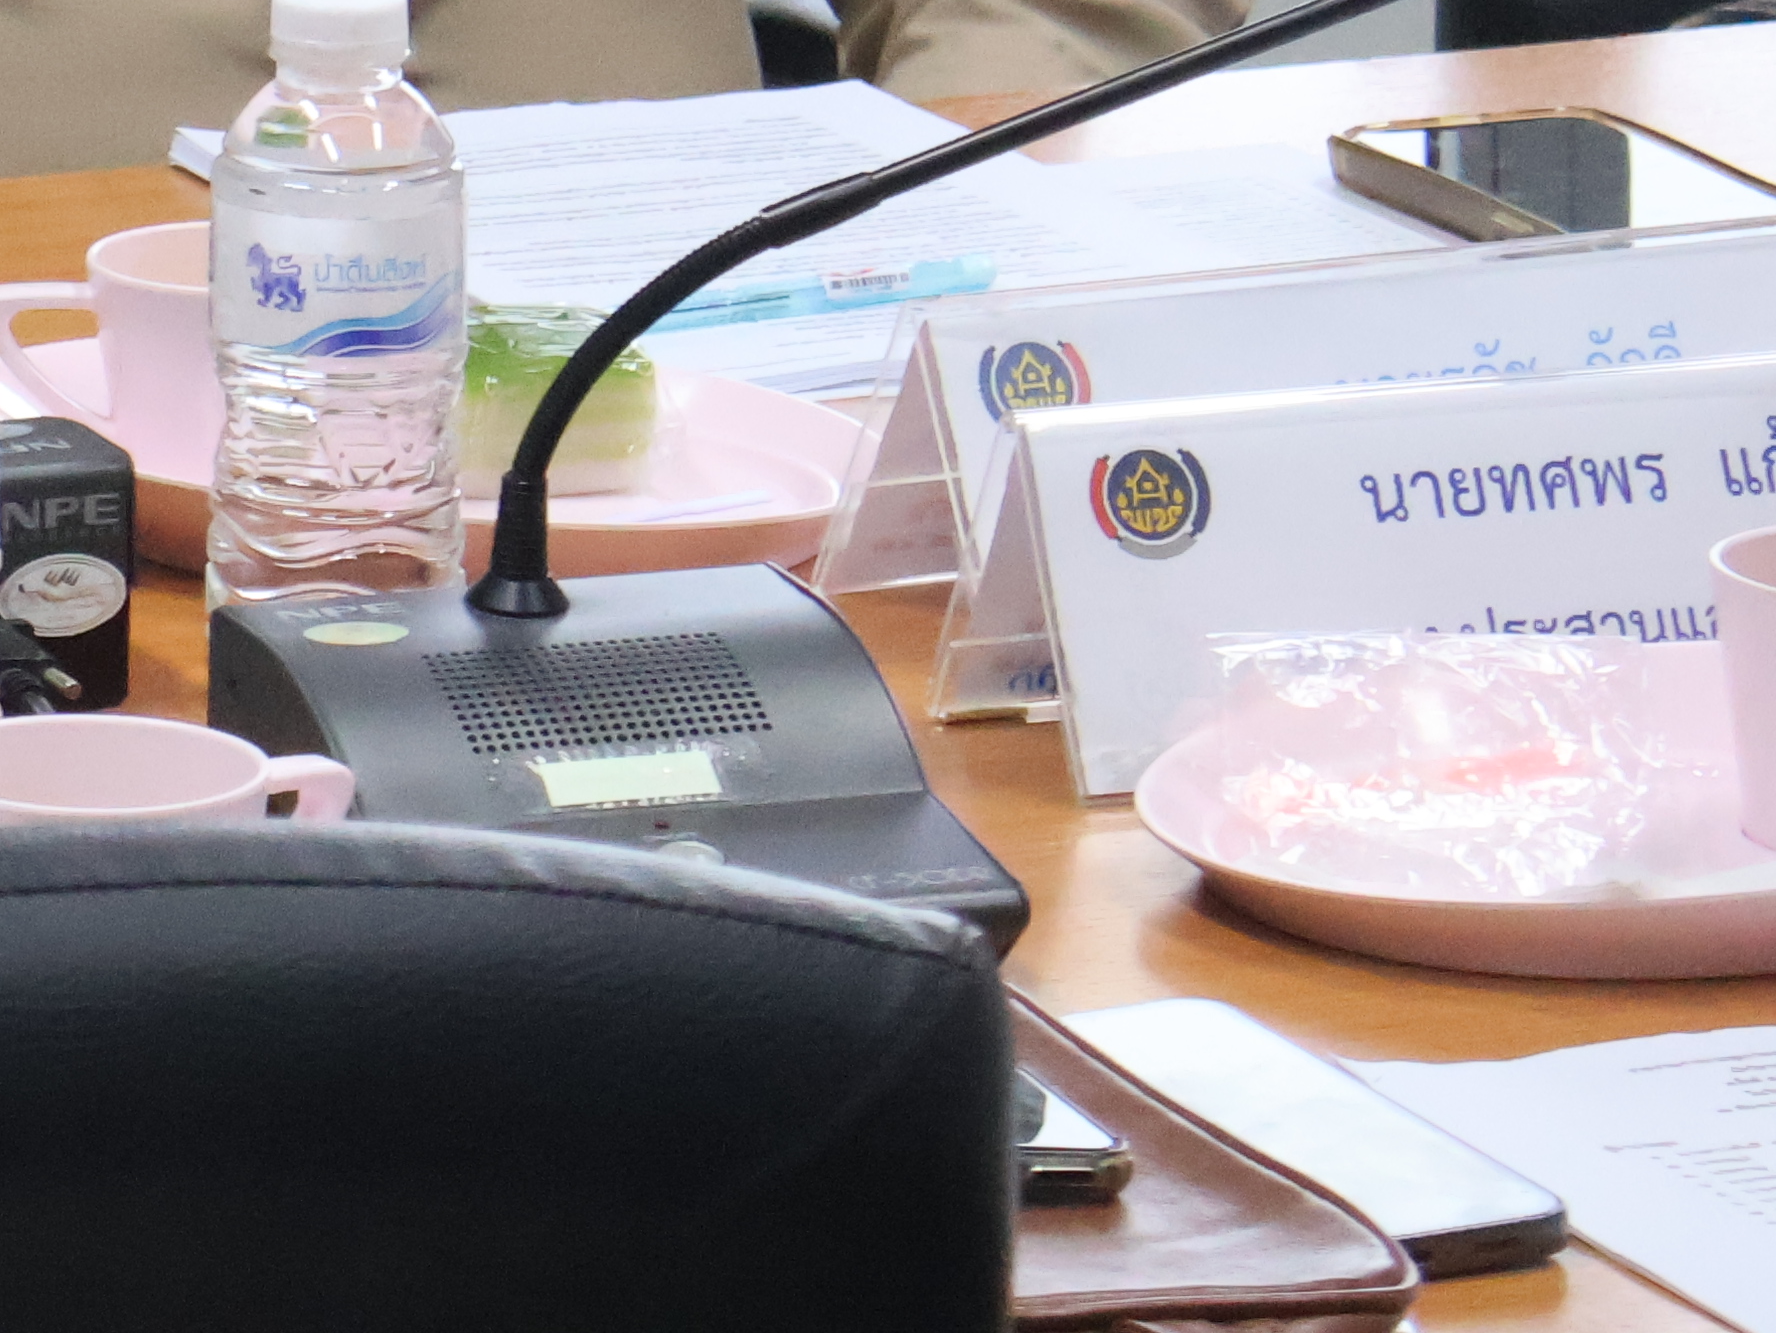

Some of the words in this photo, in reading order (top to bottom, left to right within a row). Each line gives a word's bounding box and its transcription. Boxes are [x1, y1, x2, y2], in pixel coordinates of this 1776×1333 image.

[1, 491, 122, 534] NPE
[1359, 451, 1668, 524] นายทศพร
